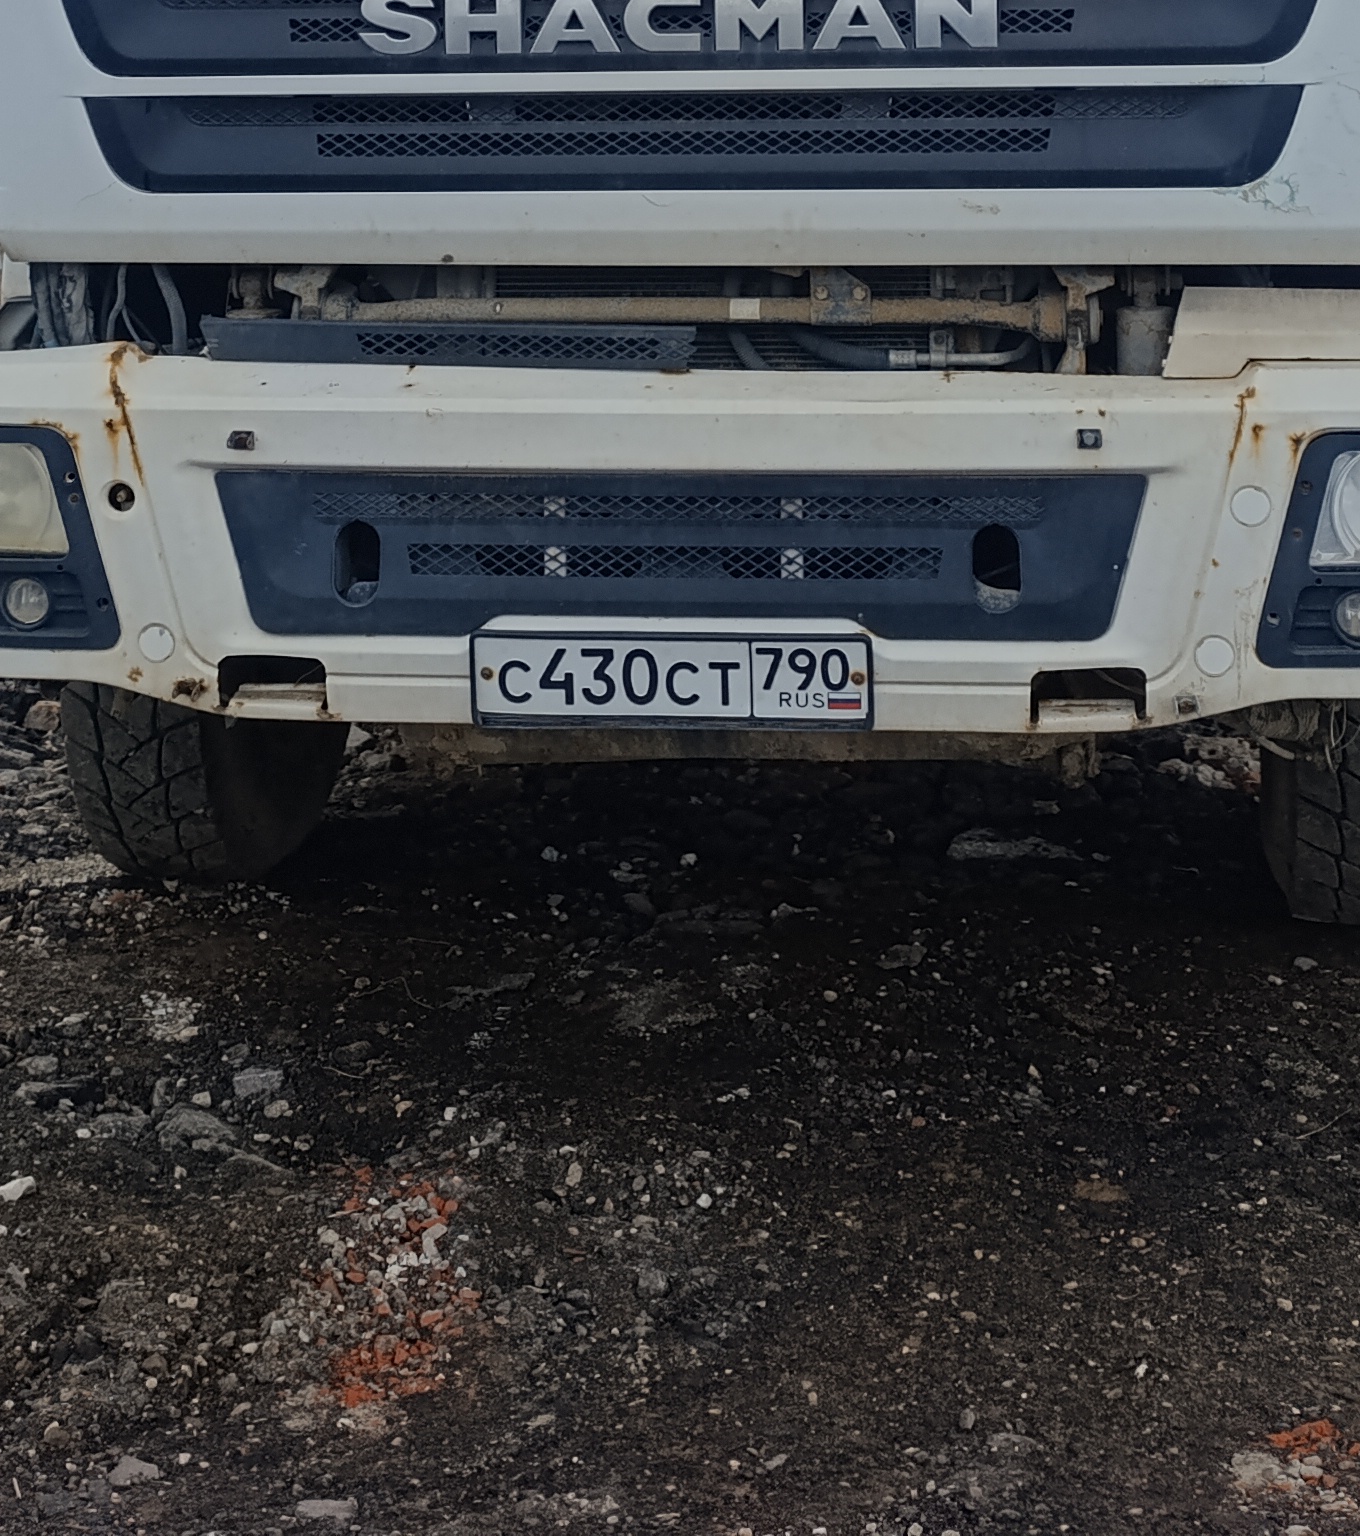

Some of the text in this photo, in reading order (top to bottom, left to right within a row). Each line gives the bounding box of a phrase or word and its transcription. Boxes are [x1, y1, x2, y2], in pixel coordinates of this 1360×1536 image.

[497, 647, 851, 706] С430СТ 790
[778, 691, 826, 709] RUS
